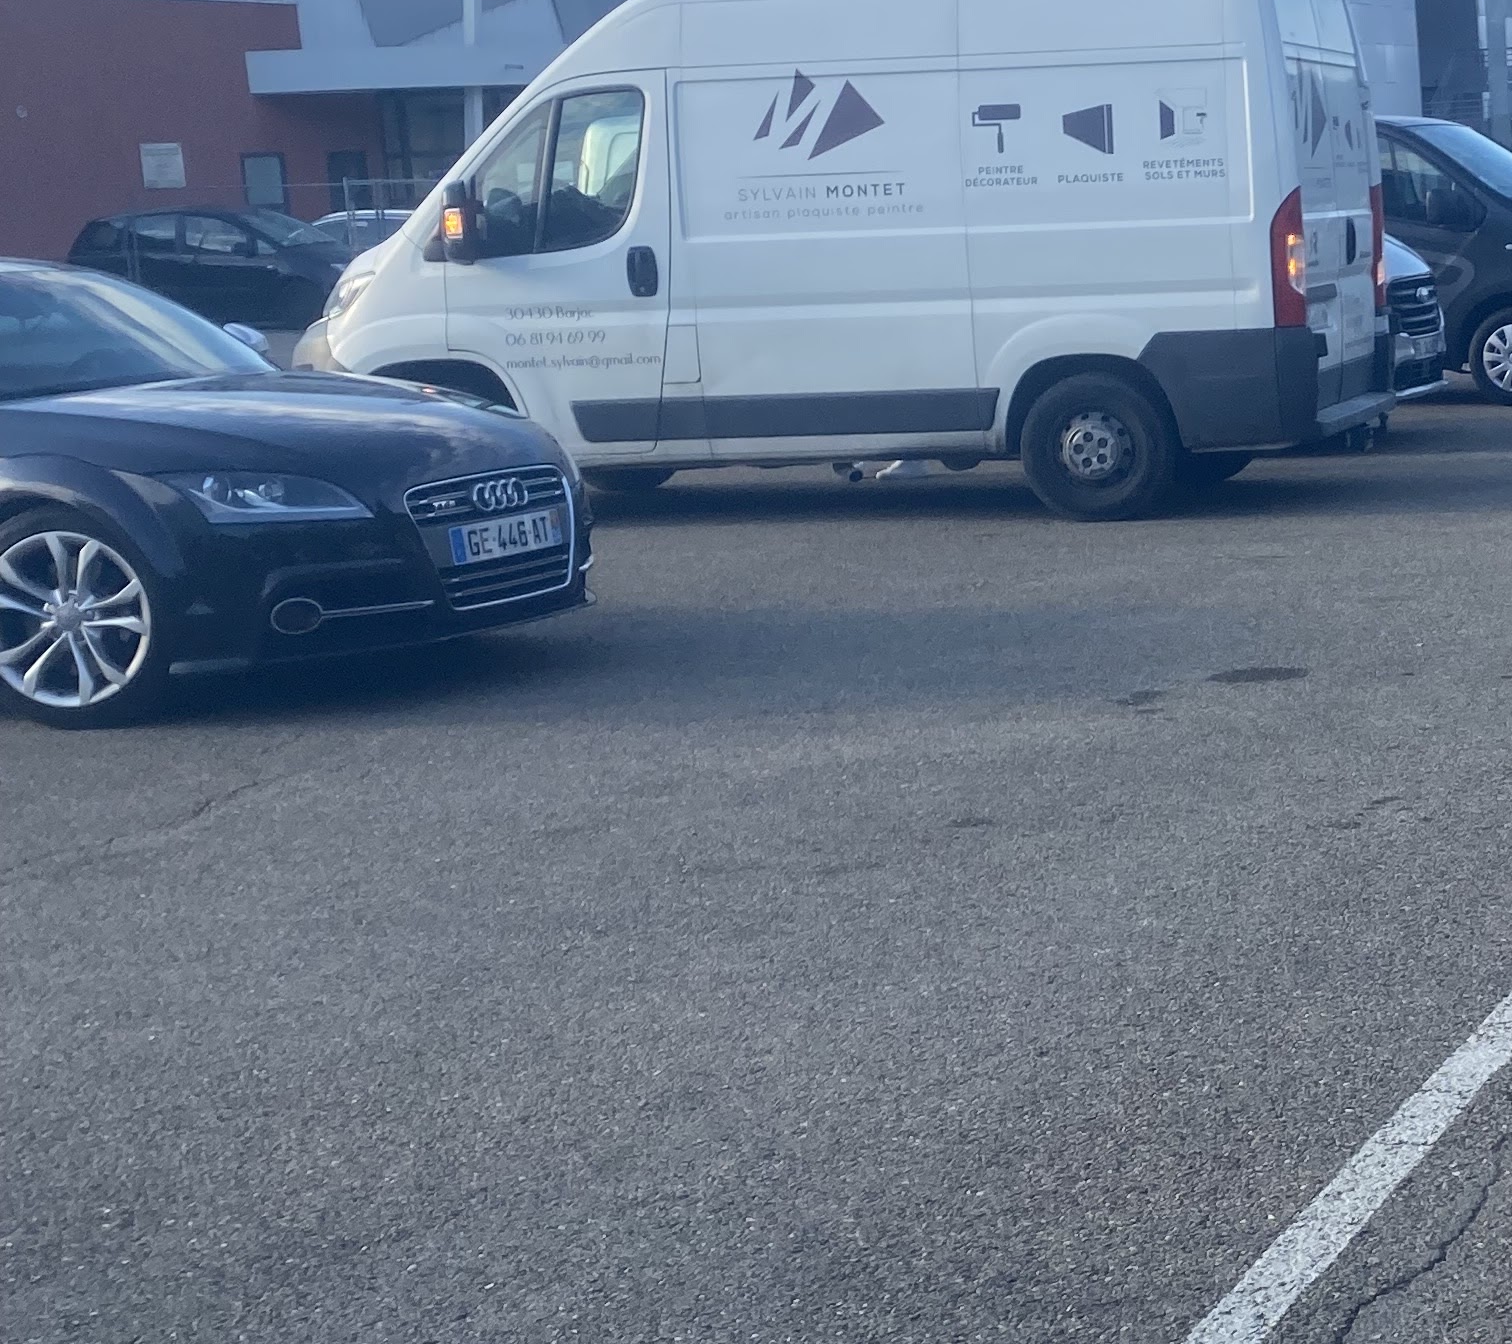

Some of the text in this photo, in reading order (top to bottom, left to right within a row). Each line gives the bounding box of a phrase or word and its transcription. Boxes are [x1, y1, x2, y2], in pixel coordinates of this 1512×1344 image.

[978, 165, 1024, 175] PEINTRE
[1145, 169, 1226, 181] SOLS ET MURS
[965, 176, 1038, 187] DÉCORATEUR
[1057, 172, 1124, 184] PLAQUISTE
[738, 182, 906, 202] SYLVAIN MONTET
[724, 203, 924, 221] artisan plaquiste peintre
[555, 305, 593, 321] Barjac
[506, 333, 526, 346] 06
[530, 332, 543, 345] 81
[588, 330, 606, 343] 99
